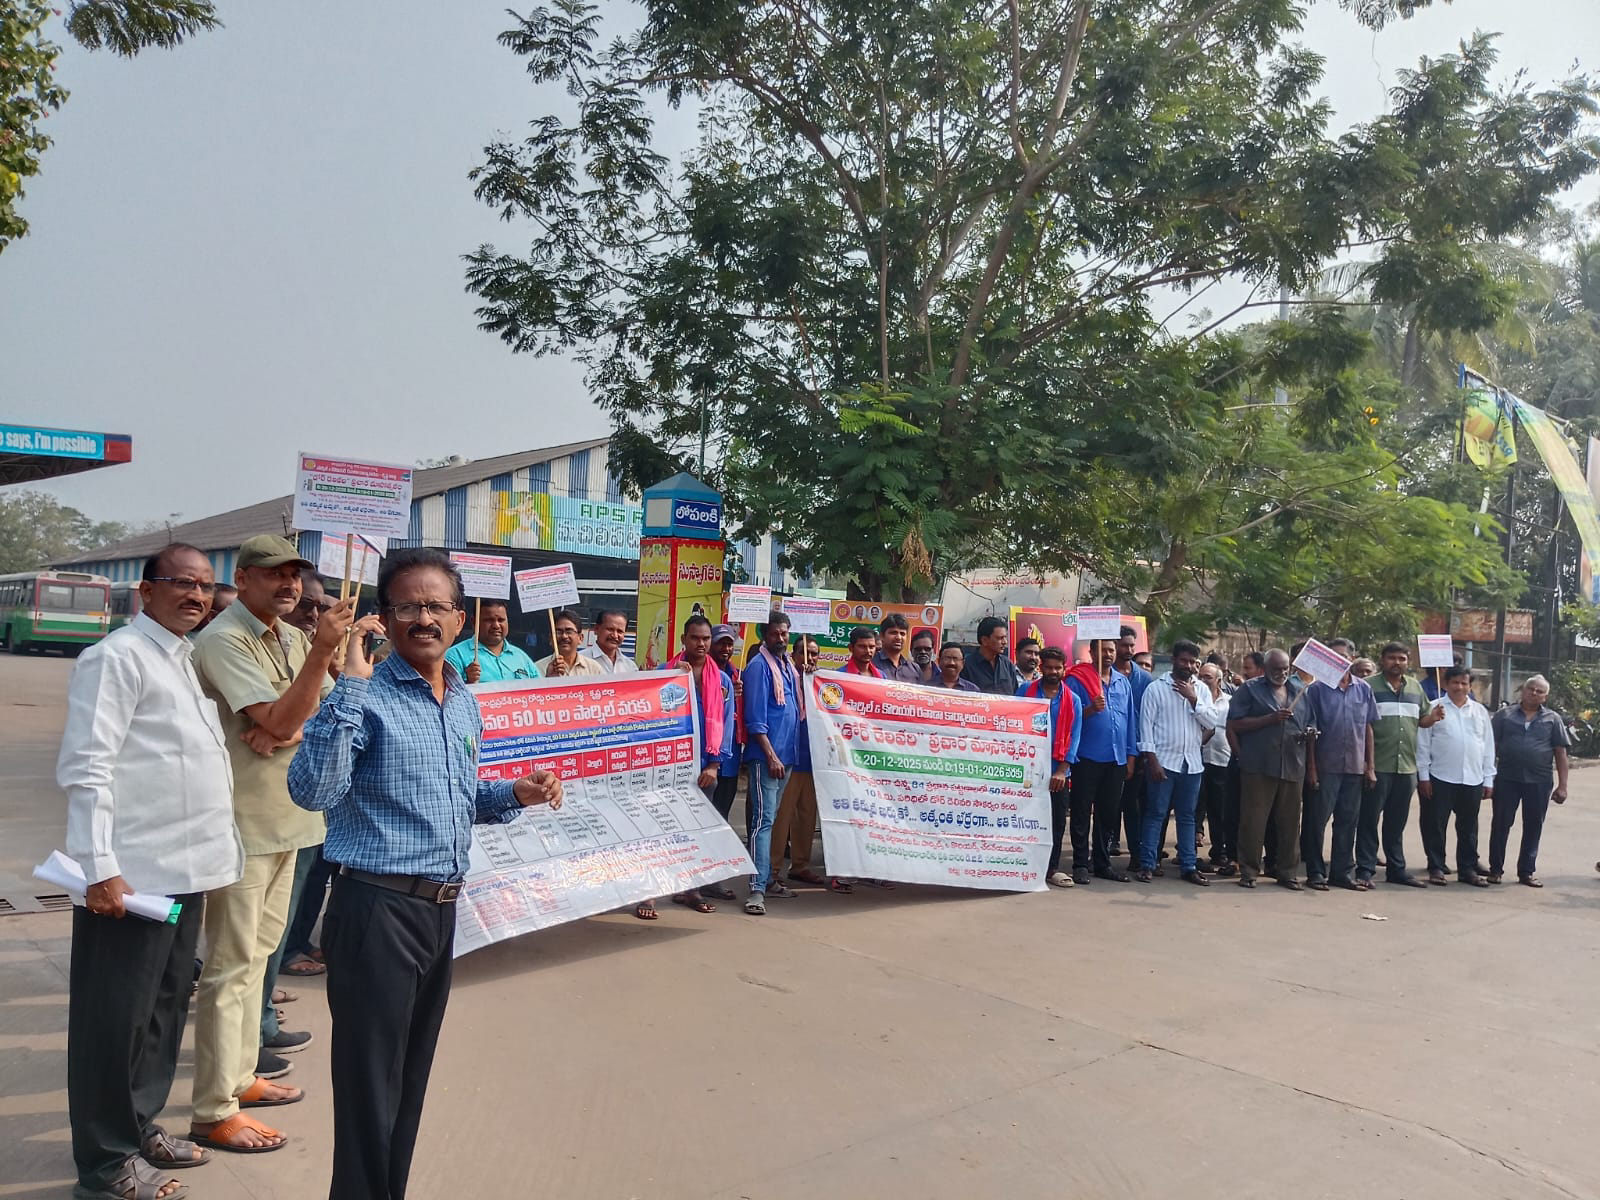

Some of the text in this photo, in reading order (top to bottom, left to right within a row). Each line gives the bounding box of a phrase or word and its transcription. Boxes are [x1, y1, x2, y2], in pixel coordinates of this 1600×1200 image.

[34, 431, 51, 450] I'm
[52, 435, 97, 454] possible
[675, 504, 718, 523] లోపలకి
[678, 562, 721, 586] సుస్వాగతం
[511, 709, 534, 728] 50
[557, 708, 570, 722] ల
[617, 697, 652, 717] వరకు
[863, 753, 922, 769] 20-12-2025
[922, 758, 944, 771] నుండి
[1005, 767, 1023, 779] వరకు
[865, 789, 876, 797] 10
[894, 779, 911, 791] ఉన్న
